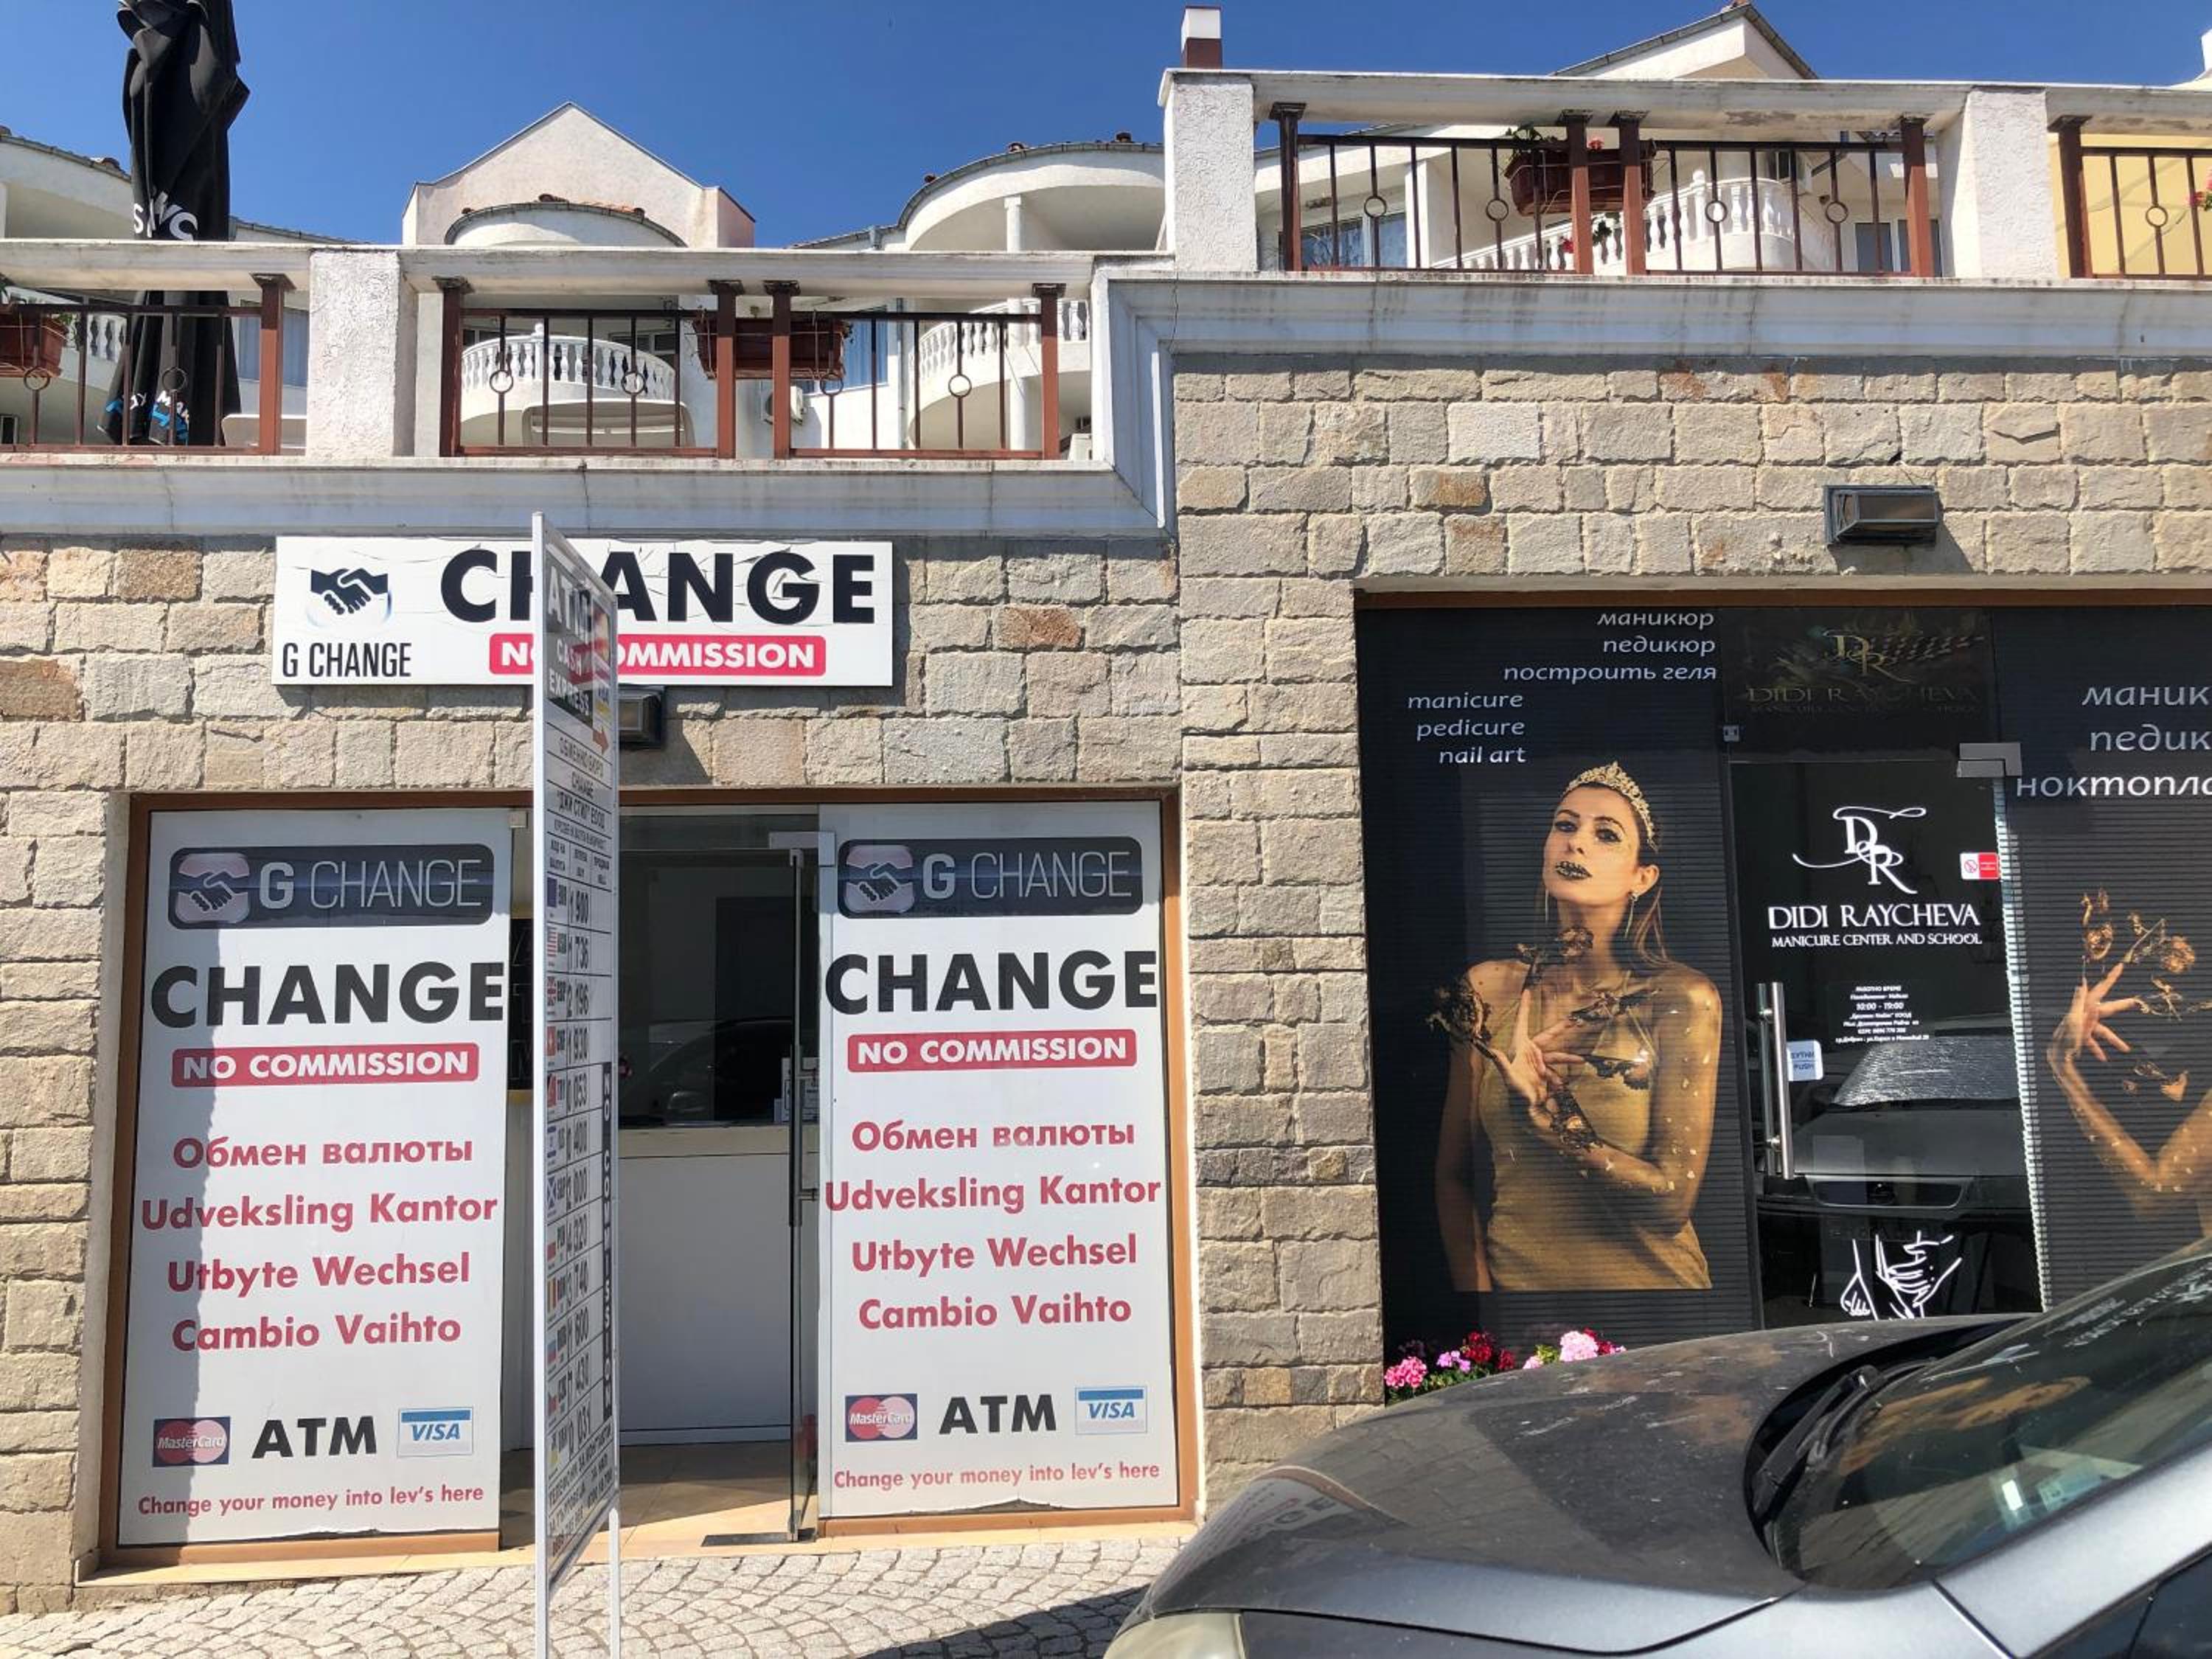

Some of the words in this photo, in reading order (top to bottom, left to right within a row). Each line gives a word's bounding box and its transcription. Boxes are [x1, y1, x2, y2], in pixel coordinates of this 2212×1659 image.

[548, 566, 589, 645] ATM
[1597, 611, 1714, 630] маникюр
[282, 644, 299, 677] G
[308, 643, 411, 678] CHANGE
[501, 643, 534, 666] N
[618, 643, 815, 669] MMISSION
[557, 639, 582, 676] CASH
[1603, 635, 1716, 655] педикюр
[1503, 666, 1656, 684] построить
[1662, 666, 1717, 681] геля
[549, 669, 589, 717] EXPRESS
[1408, 692, 1523, 709] manicure
[2081, 686, 2211, 706] маник
[1416, 719, 1525, 741] pedicure
[2090, 723, 2212, 751] педик
[1439, 747, 1482, 764] nail
[1489, 748, 1526, 763] art
[260, 862, 294, 910] G
[310, 859, 482, 908] CHANGE
[922, 853, 956, 900] G
[970, 851, 1132, 899] CHANGE
[1767, 905, 1829, 929] DIDI
[1840, 903, 1981, 928] RAYCHEVA
[1772, 934, 1840, 947] MANICURE
[1843, 934, 1893, 945] CENTER
[1896, 933, 1924, 945] AND
[1927, 933, 1982, 945] SCHOOL
[151, 961, 504, 1028] CHANGE
[825, 949, 1157, 1015] CHANGE
[1856, 1002, 1877, 1011] 10:00
[1884, 1001, 1904, 1010] 19:00
[183, 1054, 236, 1079] NO
[249, 1051, 468, 1077] COMMISSION
[858, 1040, 908, 1065] NO
[919, 1037, 1126, 1064] COMMISSION
[852, 1119, 977, 1151] Обмен
[992, 1122, 1134, 1147] валюты
[173, 1136, 307, 1169] Обмен
[322, 1140, 472, 1164] валюты
[825, 1176, 1024, 1214] Udveksling
[1040, 1175, 1161, 1205] Kantor
[142, 1193, 353, 1233] Udveksling
[369, 1192, 497, 1223] Kantor
[852, 1239, 975, 1278] Utbyte
[987, 1233, 1136, 1267] Wechsel
[167, 1259, 298, 1298] Utbyte
[312, 1251, 469, 1287] Wechsel
[859, 1295, 998, 1329] Cambio
[1011, 1292, 1131, 1324] Vaihto
[172, 1316, 319, 1352] Cambio
[335, 1311, 461, 1346] Vaihto
[849, 1412, 915, 1426] MasterCard
[939, 1394, 1057, 1434] ATM
[1088, 1401, 1135, 1420] VISA
[157, 1434, 225, 1450] MasterCard
[251, 1415, 377, 1458] ATM
[411, 1423, 461, 1442] VISA
[834, 1470, 902, 1491] Change
[911, 1470, 953, 1489] your
[960, 1467, 1022, 1486] money
[1030, 1465, 1063, 1482] into
[1071, 1462, 1112, 1481] lev's
[1119, 1461, 1160, 1478] here
[138, 1495, 212, 1517] Change
[220, 1496, 264, 1516] your
[272, 1491, 338, 1512] money
[346, 1489, 383, 1506] into
[390, 1486, 434, 1505] lev's
[442, 1484, 484, 1502] here
